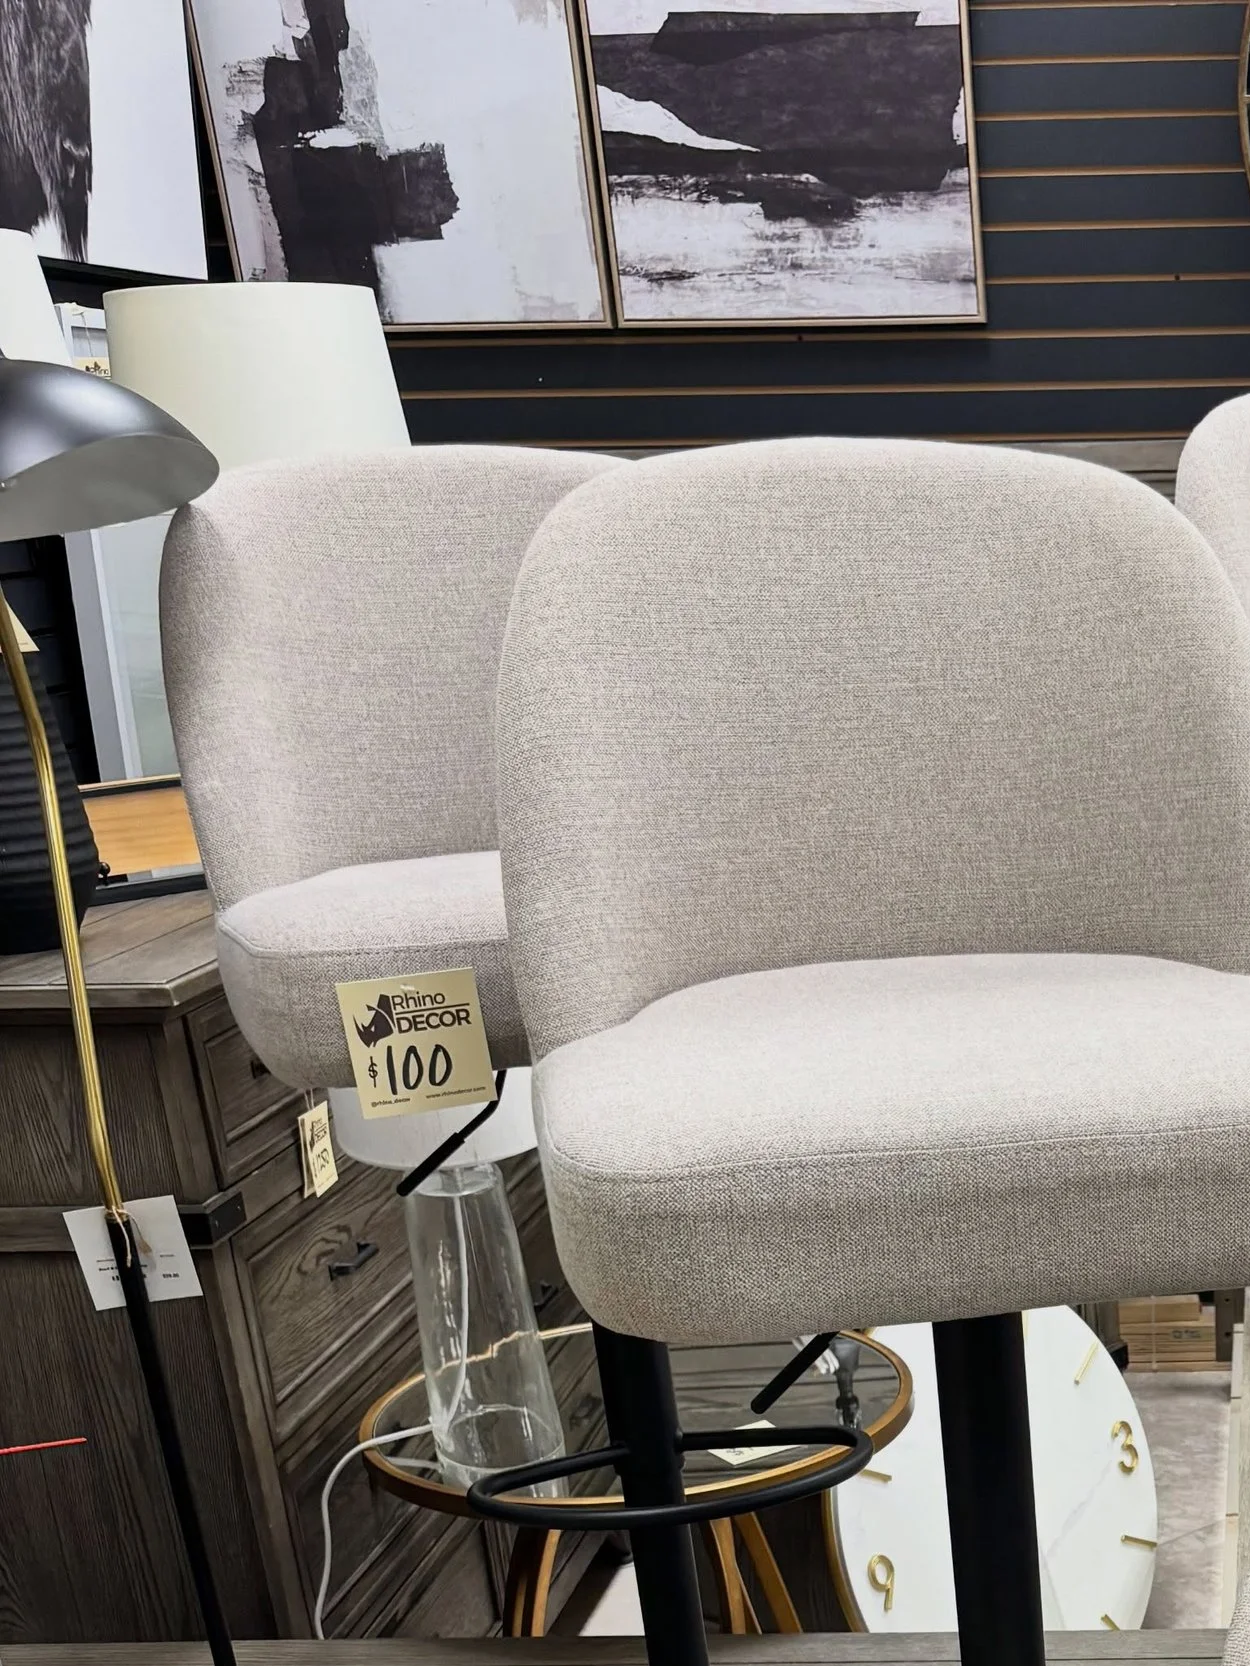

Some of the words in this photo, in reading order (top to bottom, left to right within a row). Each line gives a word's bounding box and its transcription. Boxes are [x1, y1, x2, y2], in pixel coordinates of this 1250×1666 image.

[390, 991, 446, 1011] Rhino
[395, 1008, 472, 1034] DECOR
[368, 1044, 453, 1096] $100
[1111, 1421, 1139, 1474] 3
[867, 1552, 895, 1612] 9
